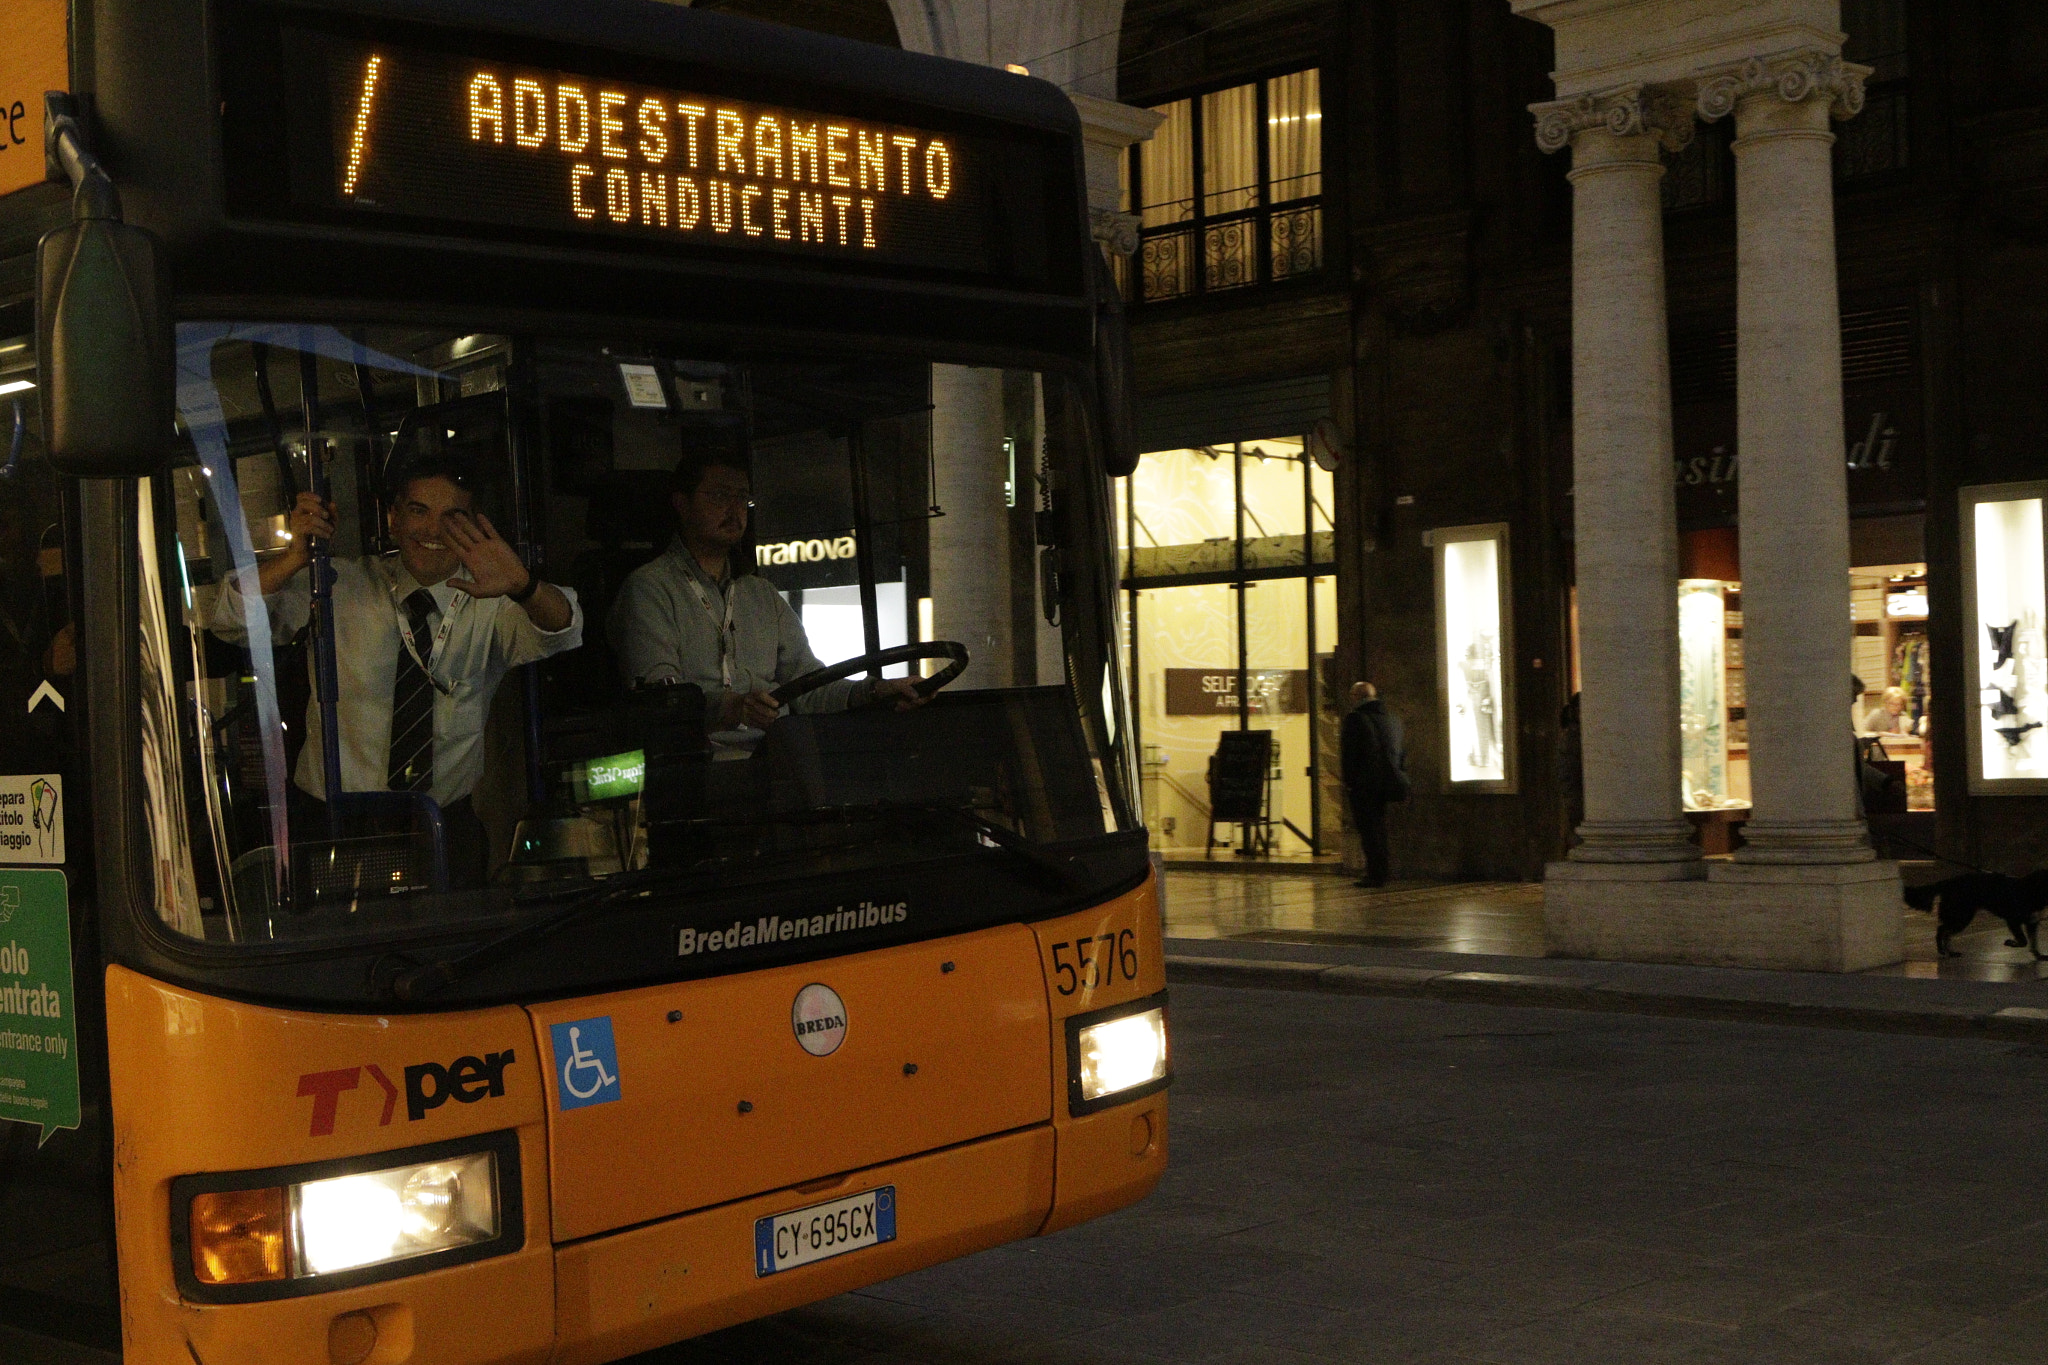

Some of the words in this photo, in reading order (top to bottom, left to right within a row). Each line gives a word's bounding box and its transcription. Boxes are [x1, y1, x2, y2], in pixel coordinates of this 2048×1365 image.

[469, 72, 952, 200] ADDESTRAMENTO
[571, 163, 877, 249] CONDUCENTI
[1202, 676, 1237, 693] SELF
[0, 793, 25, 808] para
[677, 901, 908, 957] BredaMenarinibus
[1051, 928, 1138, 996] 5576
[0, 1028, 42, 1052] ntrance
[44, 1032, 68, 1060] only
[796, 1014, 845, 1036] BREDA
